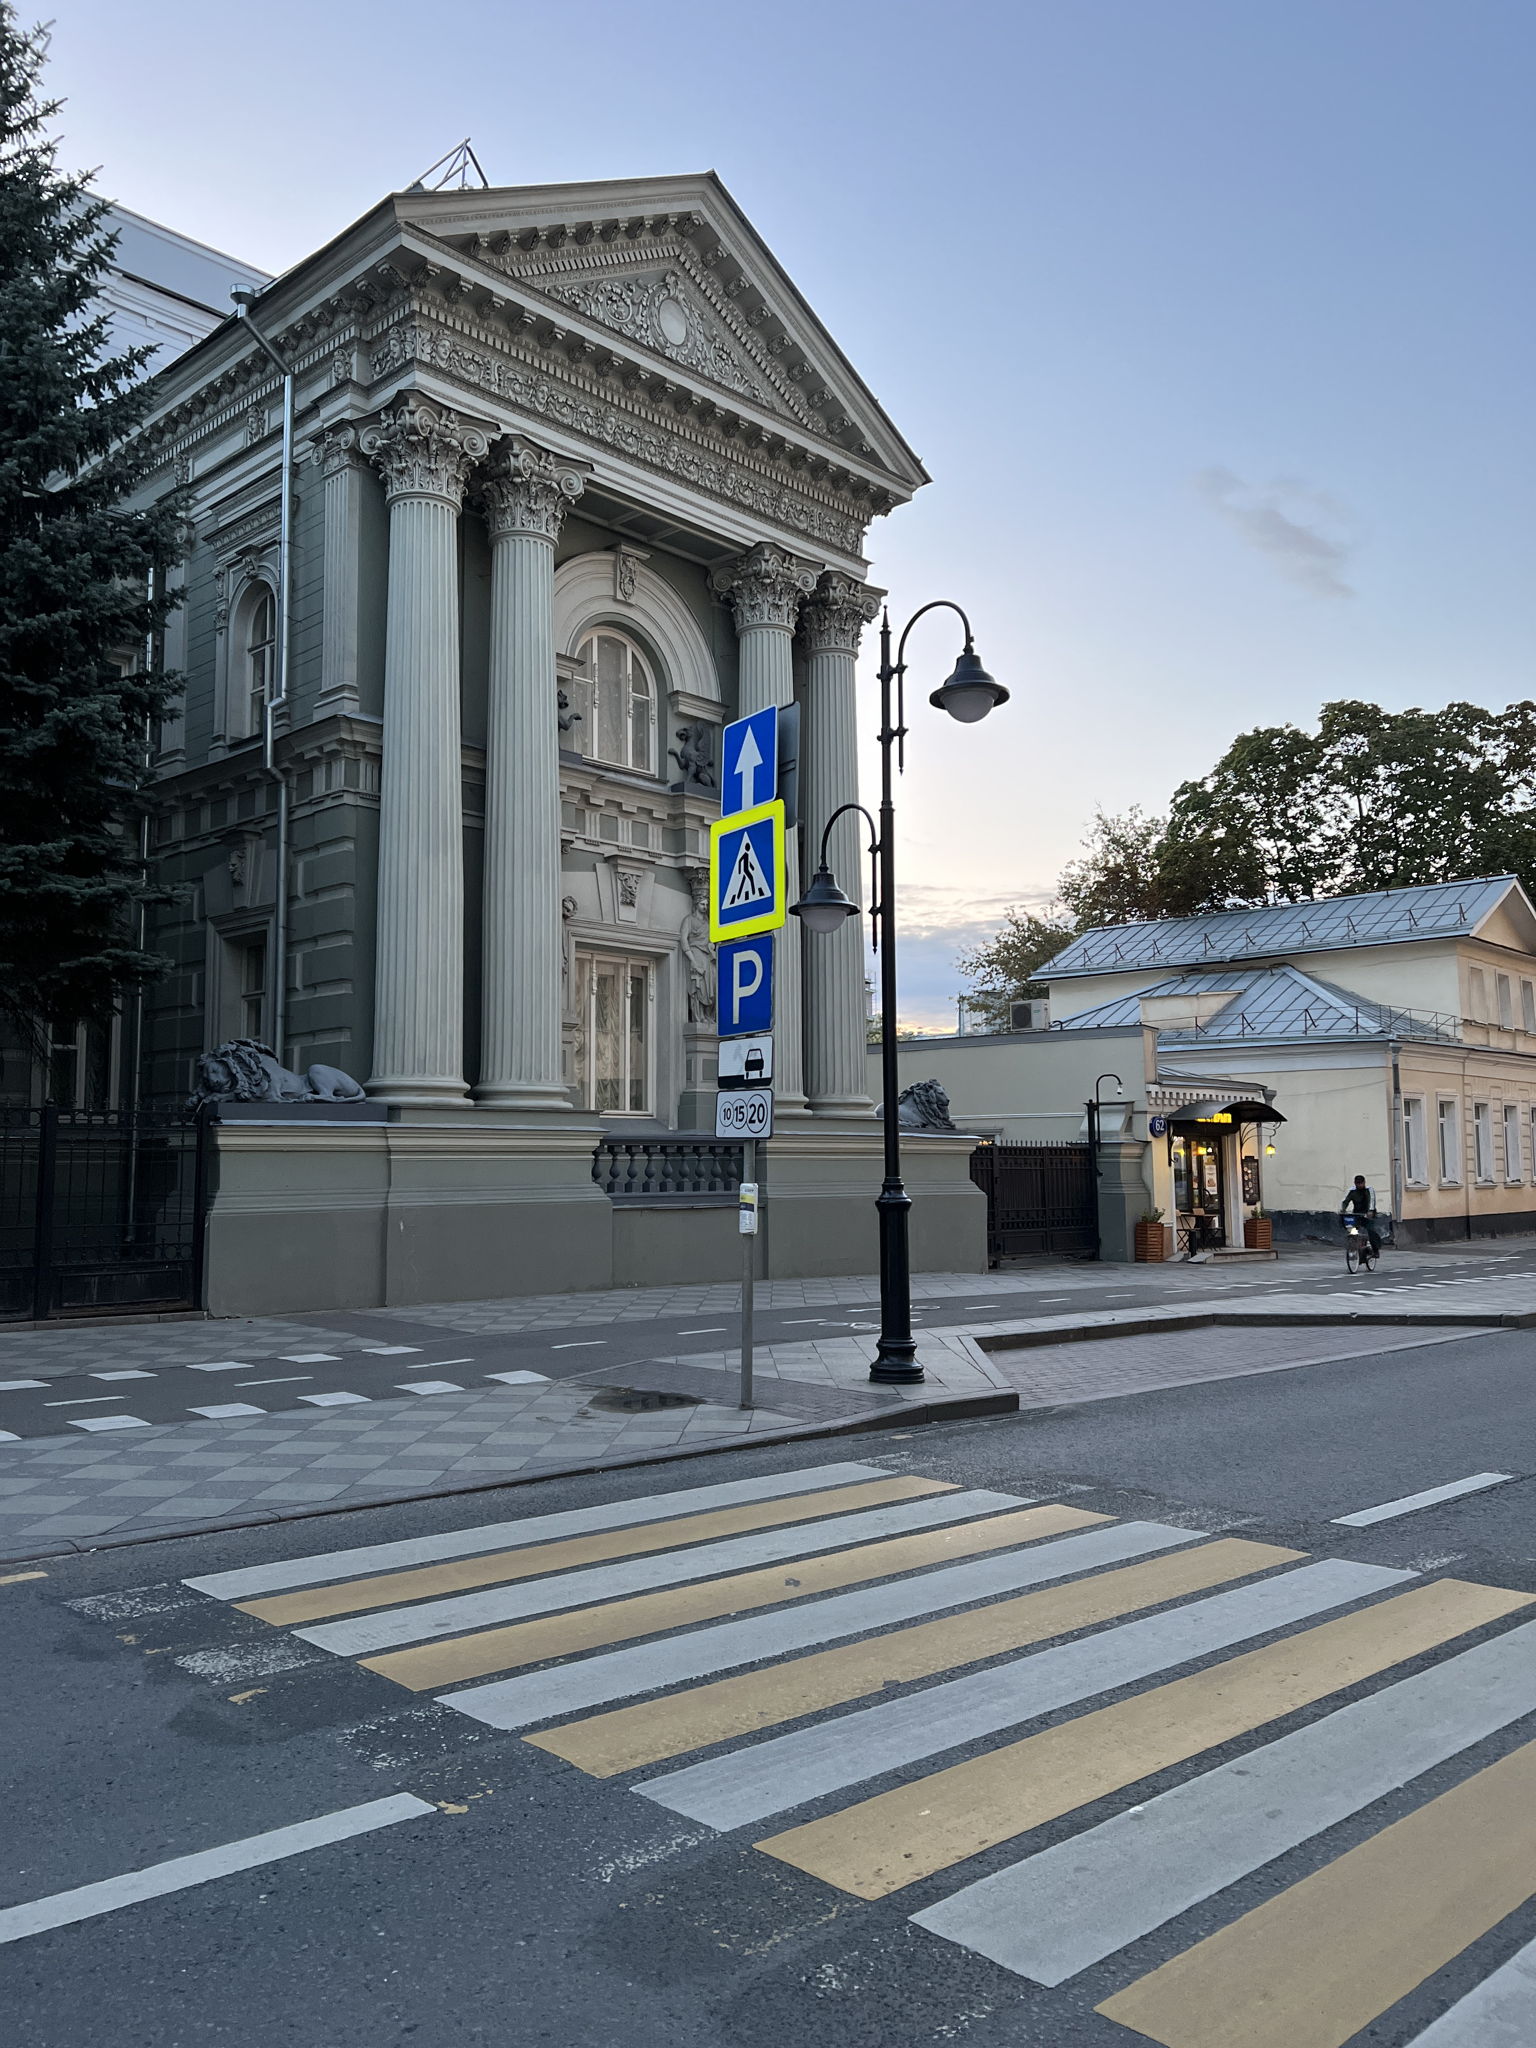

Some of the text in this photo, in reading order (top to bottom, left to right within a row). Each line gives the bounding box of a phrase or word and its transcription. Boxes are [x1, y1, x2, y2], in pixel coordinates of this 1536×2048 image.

[732, 950, 763, 1024] P
[723, 1103, 765, 1124] 10 15 20
[1155, 1120, 1164, 1131] 62
